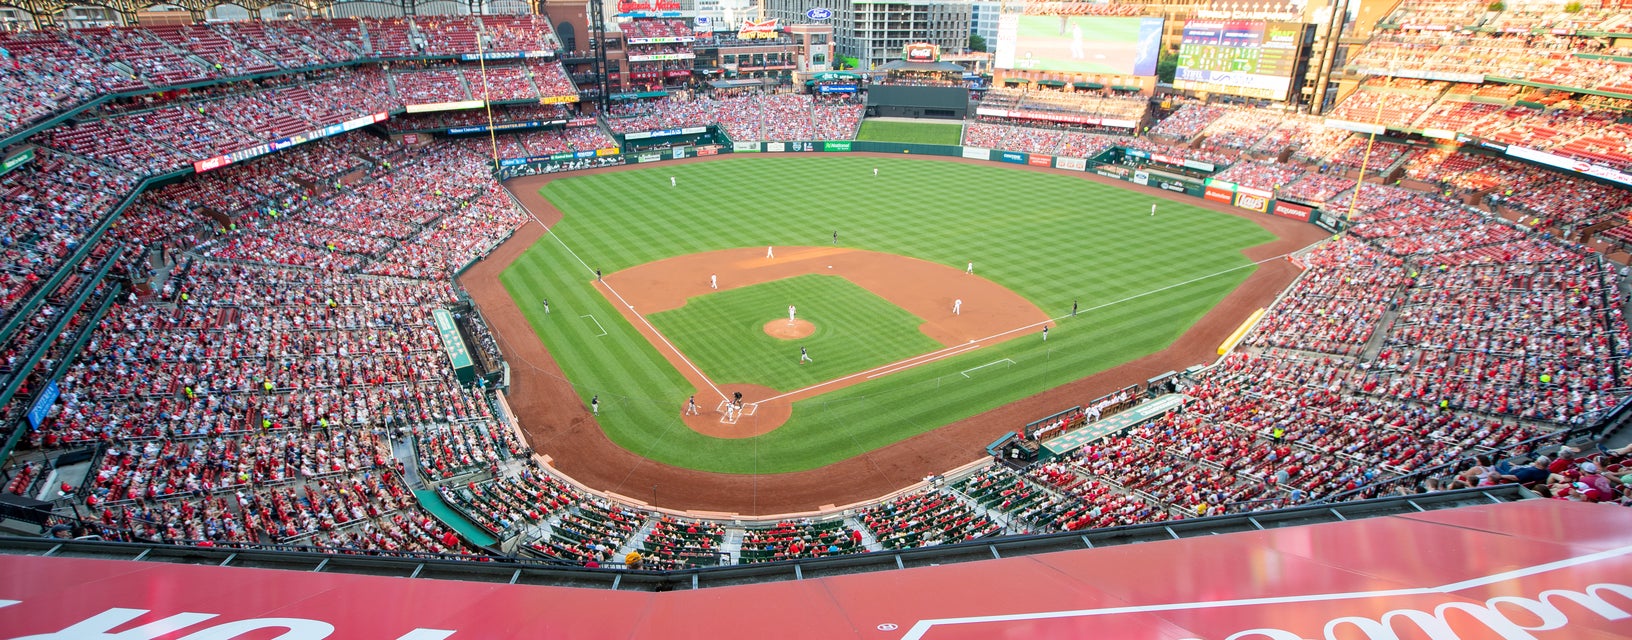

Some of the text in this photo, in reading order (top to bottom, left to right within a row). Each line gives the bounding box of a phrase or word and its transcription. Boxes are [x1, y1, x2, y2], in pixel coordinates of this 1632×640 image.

[649, 0, 681, 12] Nation
[1023, 2, 1146, 15] Budweiser
[811, 9, 829, 18] Ford
